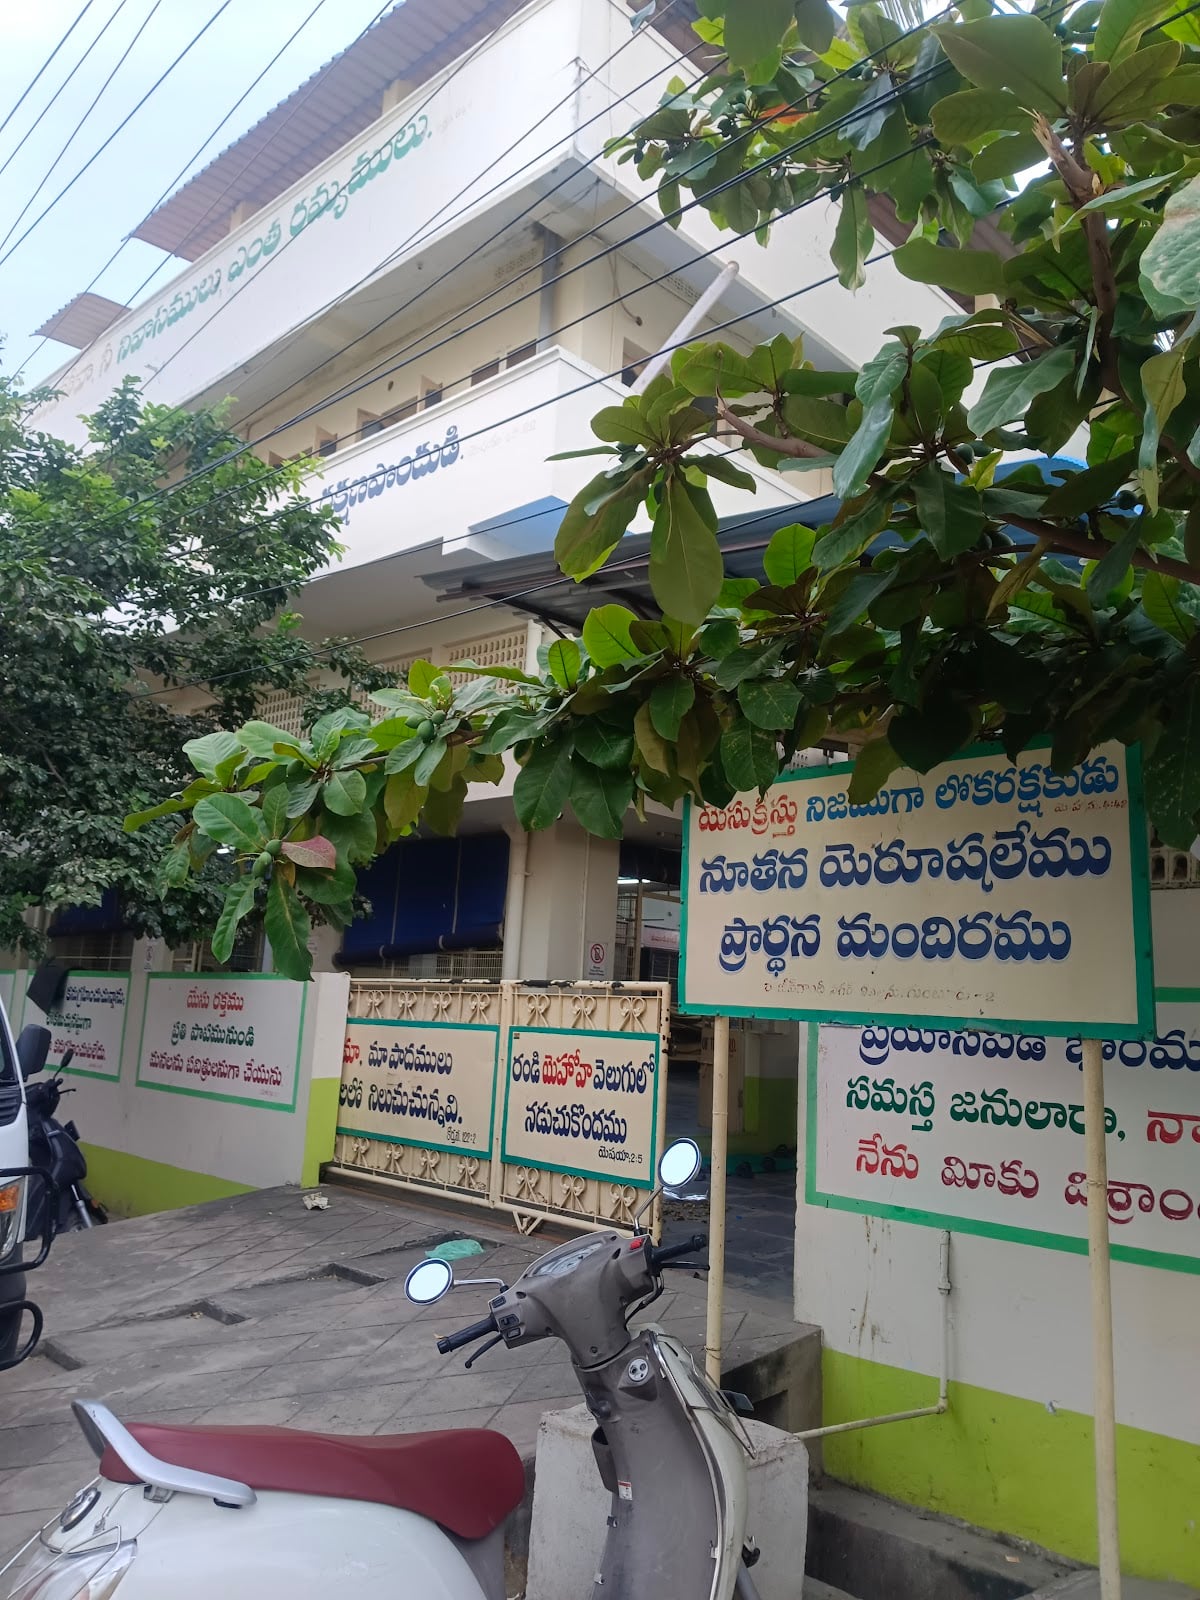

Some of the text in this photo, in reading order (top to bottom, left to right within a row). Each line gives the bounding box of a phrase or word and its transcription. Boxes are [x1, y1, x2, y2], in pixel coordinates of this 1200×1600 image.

[700, 819, 1112, 894] నూతన యెరూషలేము
[836, 910, 1072, 962] మందిరము
[213, 991, 244, 1017] రక్తము
[171, 1021, 255, 1047] ప్రతి పాపమునుండి
[512, 1049, 656, 1093] రండి యెహోవా వెలుగులో
[525, 1101, 627, 1144] నడుచుకొందము
[846, 1075, 935, 1132] సమస్త
[855, 1133, 920, 1180] నేను
